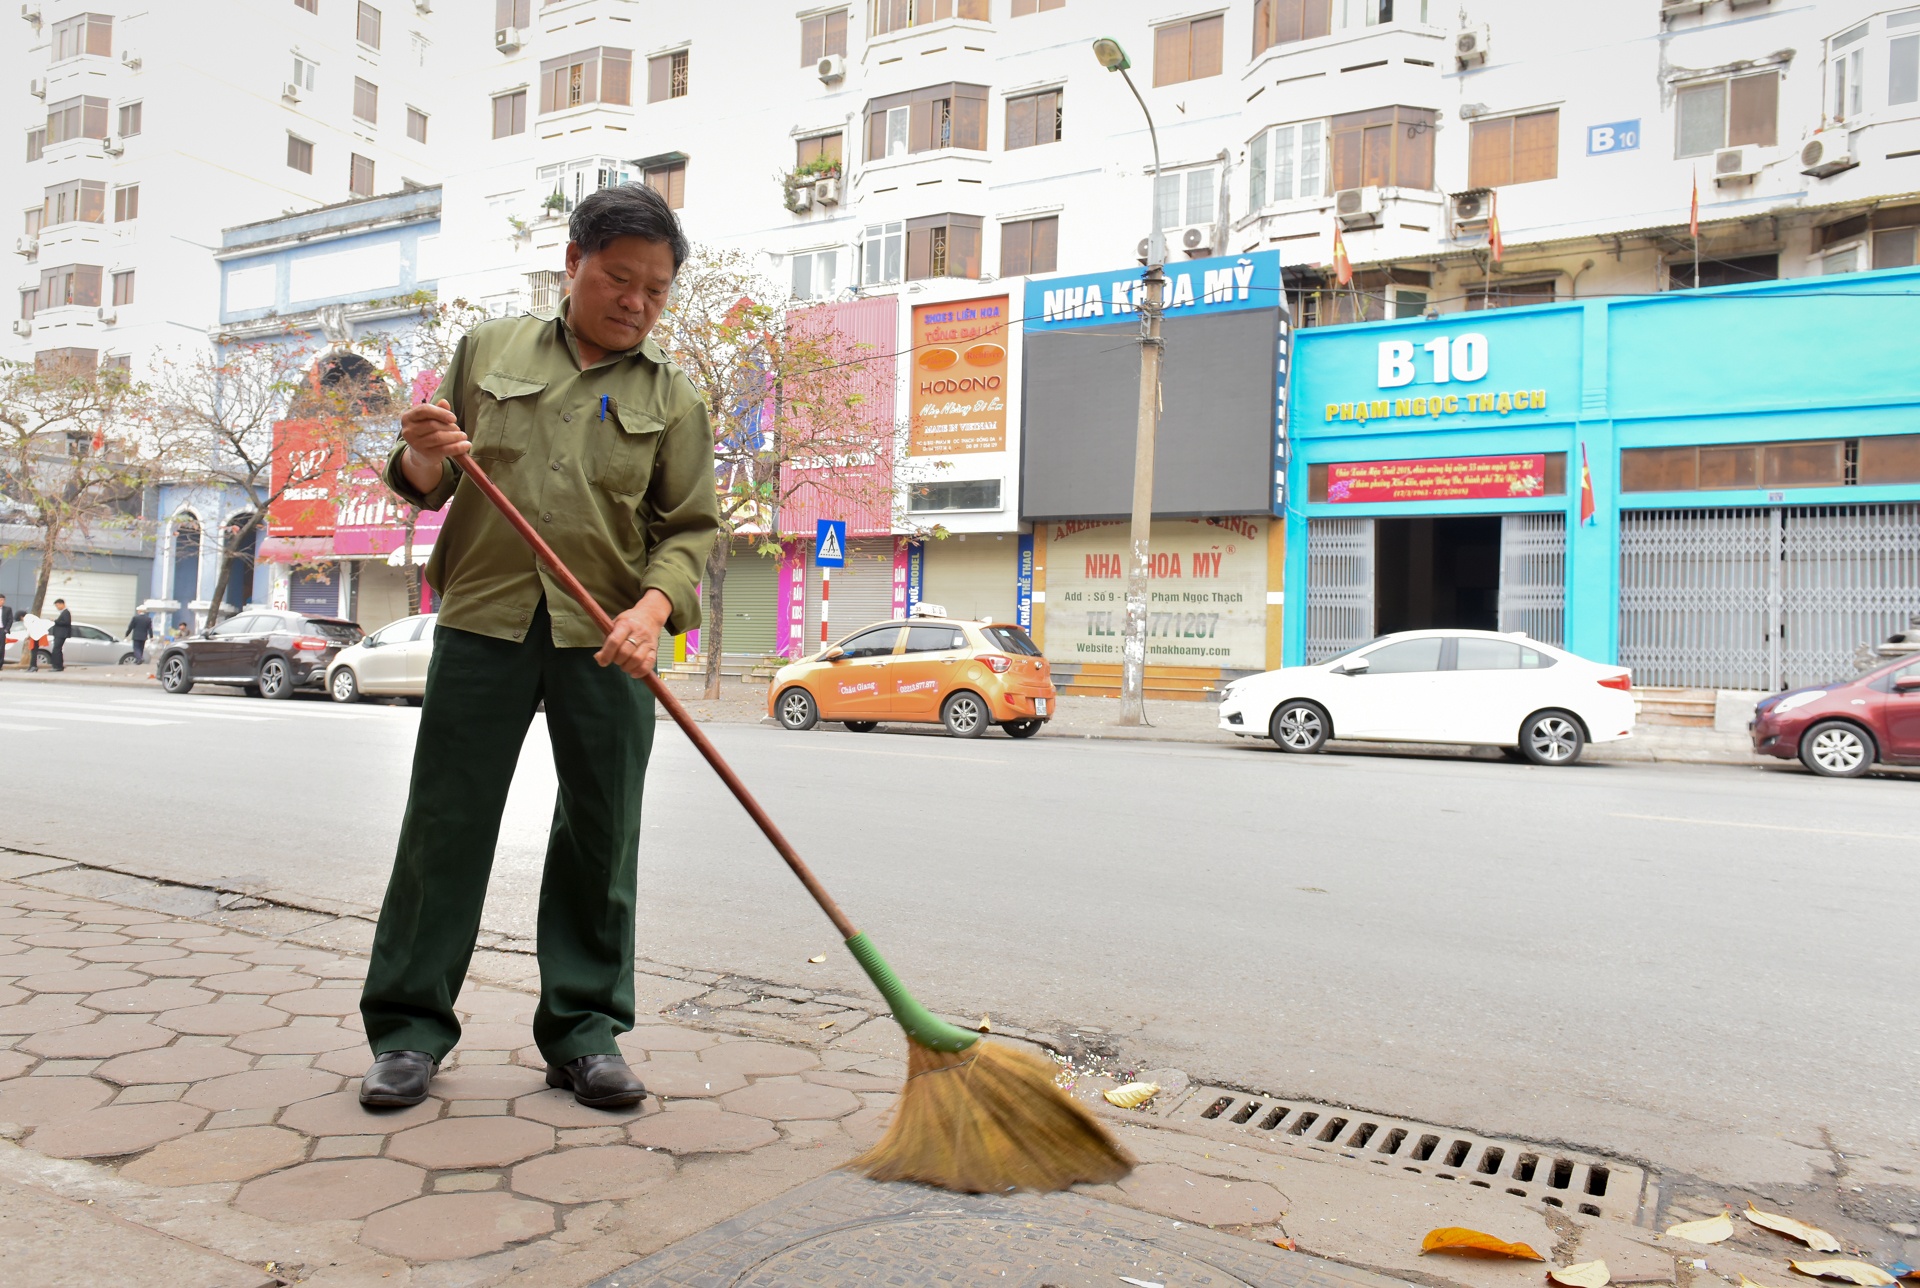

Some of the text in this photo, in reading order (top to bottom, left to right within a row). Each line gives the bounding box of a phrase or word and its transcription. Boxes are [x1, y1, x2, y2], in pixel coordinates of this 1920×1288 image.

[1592, 127, 1637, 152] B 10
[1043, 284, 1104, 322] NHA
[1203, 258, 1255, 304] MỸ
[1377, 332, 1489, 388] B 10
[921, 375, 1001, 395] HODONO
[1325, 389, 1547, 423] PHẠM NGỌC THẠCH
[1022, 550, 1032, 576] THAO
[1085, 545, 1222, 579] NHA HOA MỸ
[1064, 591, 1082, 602] Add
[1093, 590, 1107, 602] Số
[1108, 592, 1115, 602] 9
[1151, 592, 1180, 604] Phạm
[1182, 592, 1209, 604] Ngọc
[1212, 592, 1243, 604] Thạch
[1086, 611, 1116, 636] TEL
[1076, 643, 1113, 653] Website
[856, 681, 876, 692] Giang
